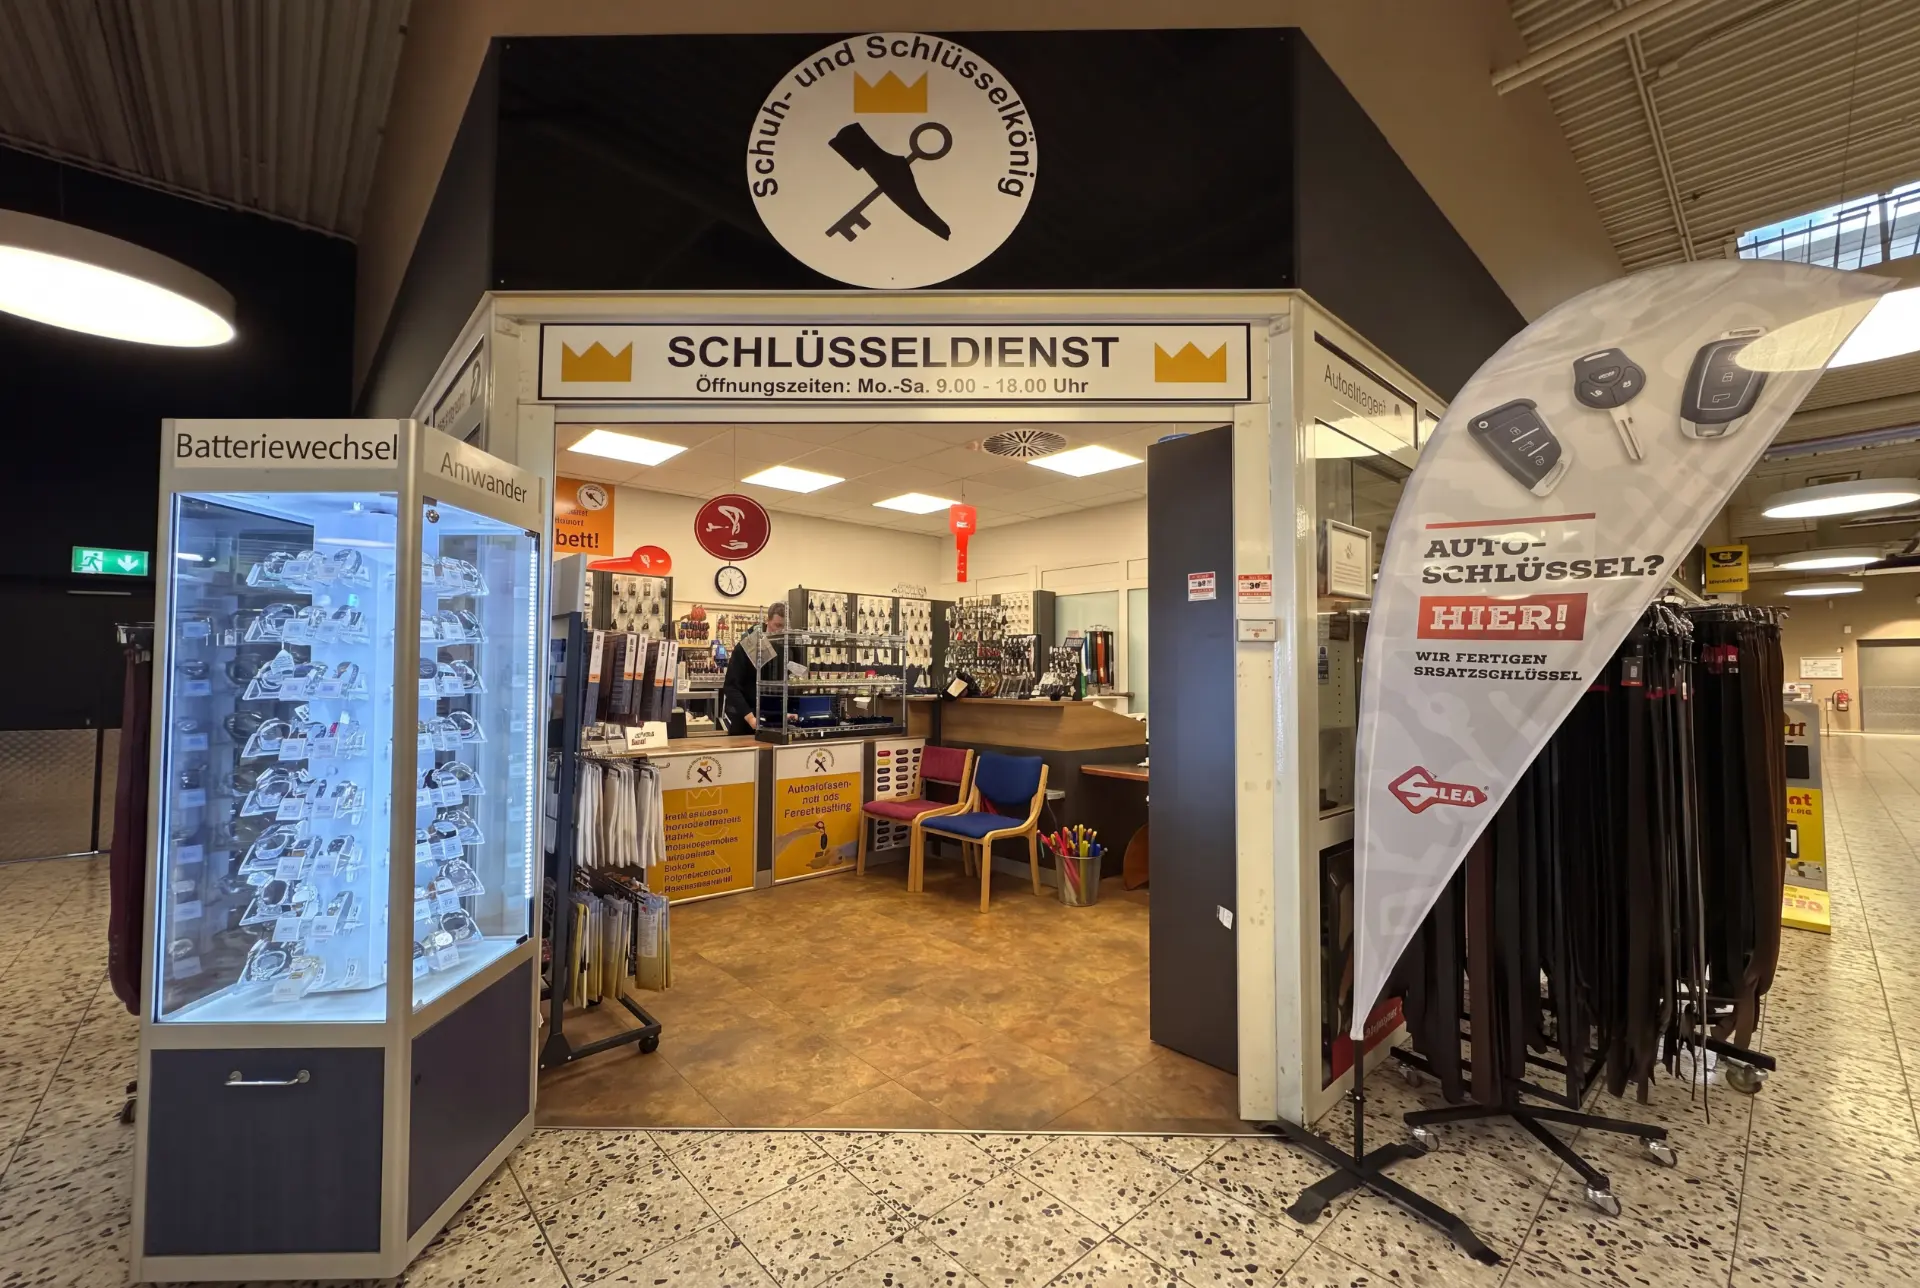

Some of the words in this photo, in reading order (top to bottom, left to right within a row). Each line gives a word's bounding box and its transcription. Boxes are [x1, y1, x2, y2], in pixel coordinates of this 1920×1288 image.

[749, 91, 792, 198] Schuh-
[794, 43, 856, 88] und
[866, 35, 1036, 198] Schlüsselkönig
[667, 329, 1120, 369] SCHLÜSSELDIENST
[695, 374, 851, 397] Öffnungszeiten:
[857, 377, 930, 394] Mo.-Sa.
[936, 377, 976, 394] 9.00
[995, 377, 1047, 394] 18.00
[1053, 377, 1089, 394] Uhr
[176, 432, 399, 460] Batteriewechsel
[555, 528, 599, 549] bett!
[1423, 537, 1547, 559] AUTO-
[1421, 554, 1665, 584] SCHLÜSSEL?
[1430, 604, 1568, 631] HIER!
[1415, 651, 1451, 663] WIR
[1455, 652, 1548, 665] FERTIGEN
